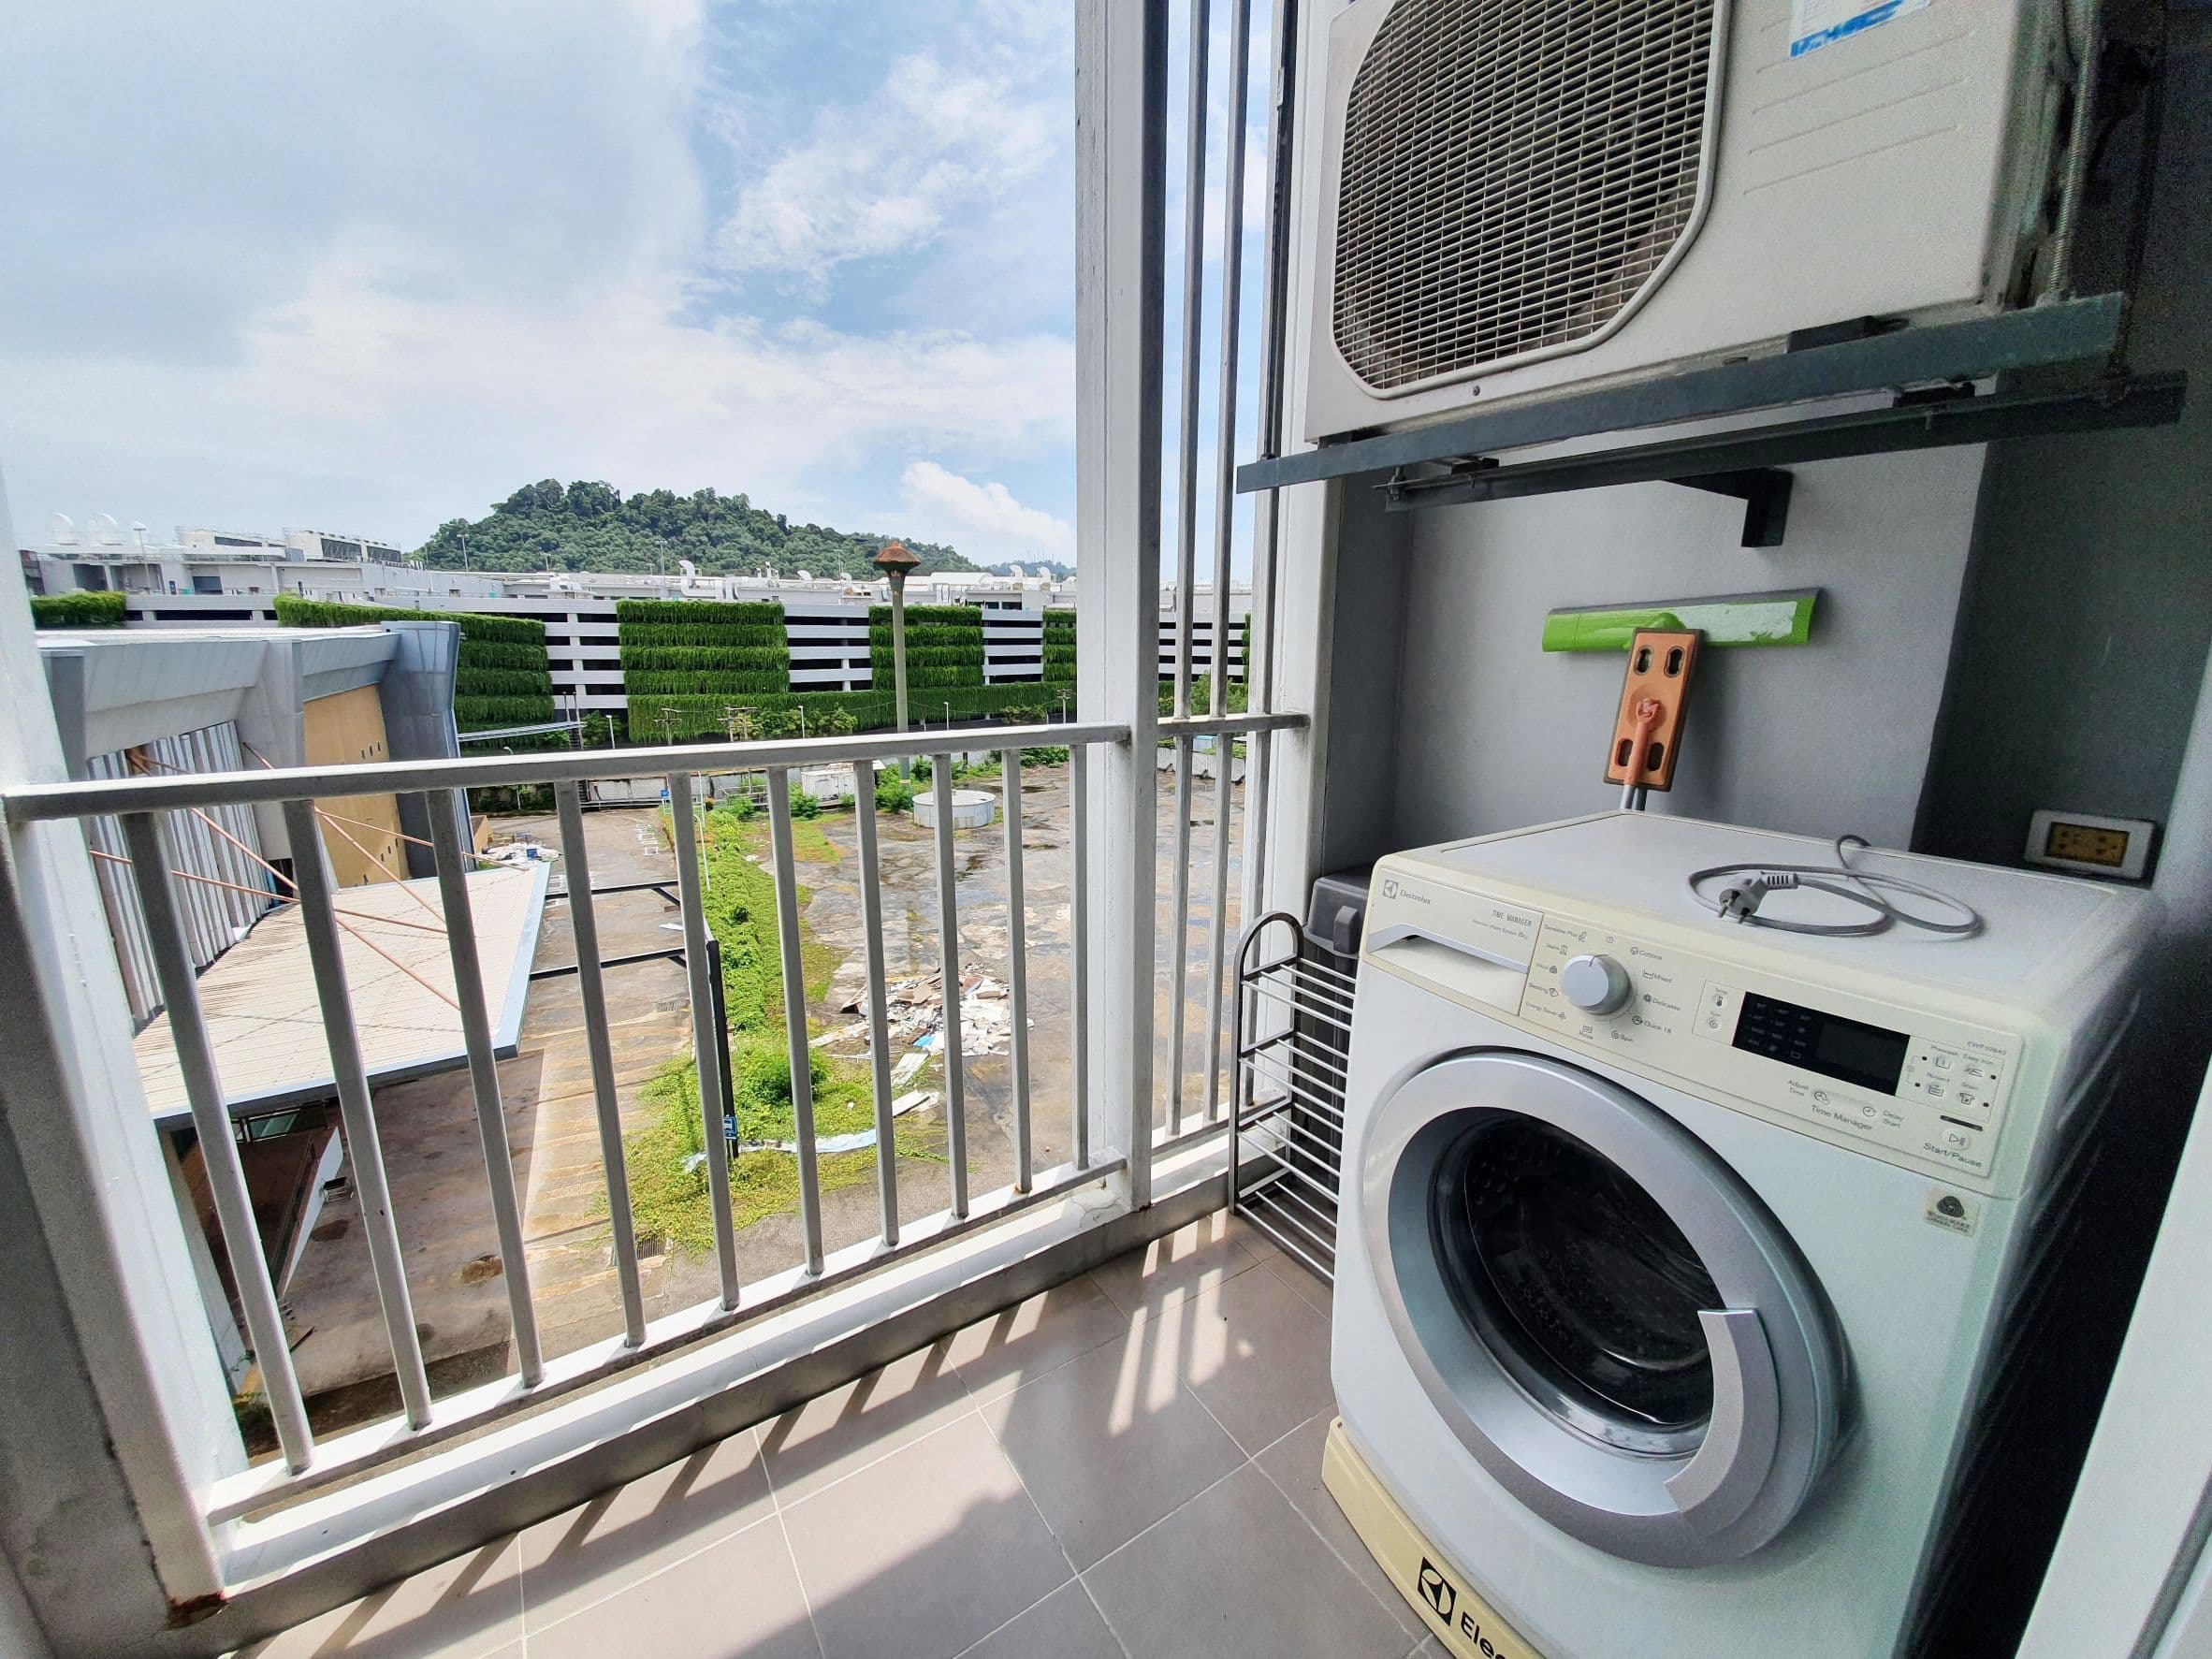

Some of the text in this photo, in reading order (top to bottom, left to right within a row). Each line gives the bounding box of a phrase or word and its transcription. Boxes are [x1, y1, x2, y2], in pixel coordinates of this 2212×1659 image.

[1400, 890, 1431, 905] Electrolux
[1492, 910, 1533, 927] TIME MANAGER
[1639, 950, 1662, 960] Cottons
[1652, 998, 1681, 1011] Delicates
[1644, 1020, 1663, 1031] Quick
[1620, 1034, 1634, 1042] Spin
[1788, 1079, 1810, 1090] Adjust
[1789, 1087, 1804, 1097] Time
[1812, 1104, 1872, 1130] Time Manager
[1923, 1142, 1983, 1168] Start/Pause
[1461, 1611, 1506, 1659] Ele
